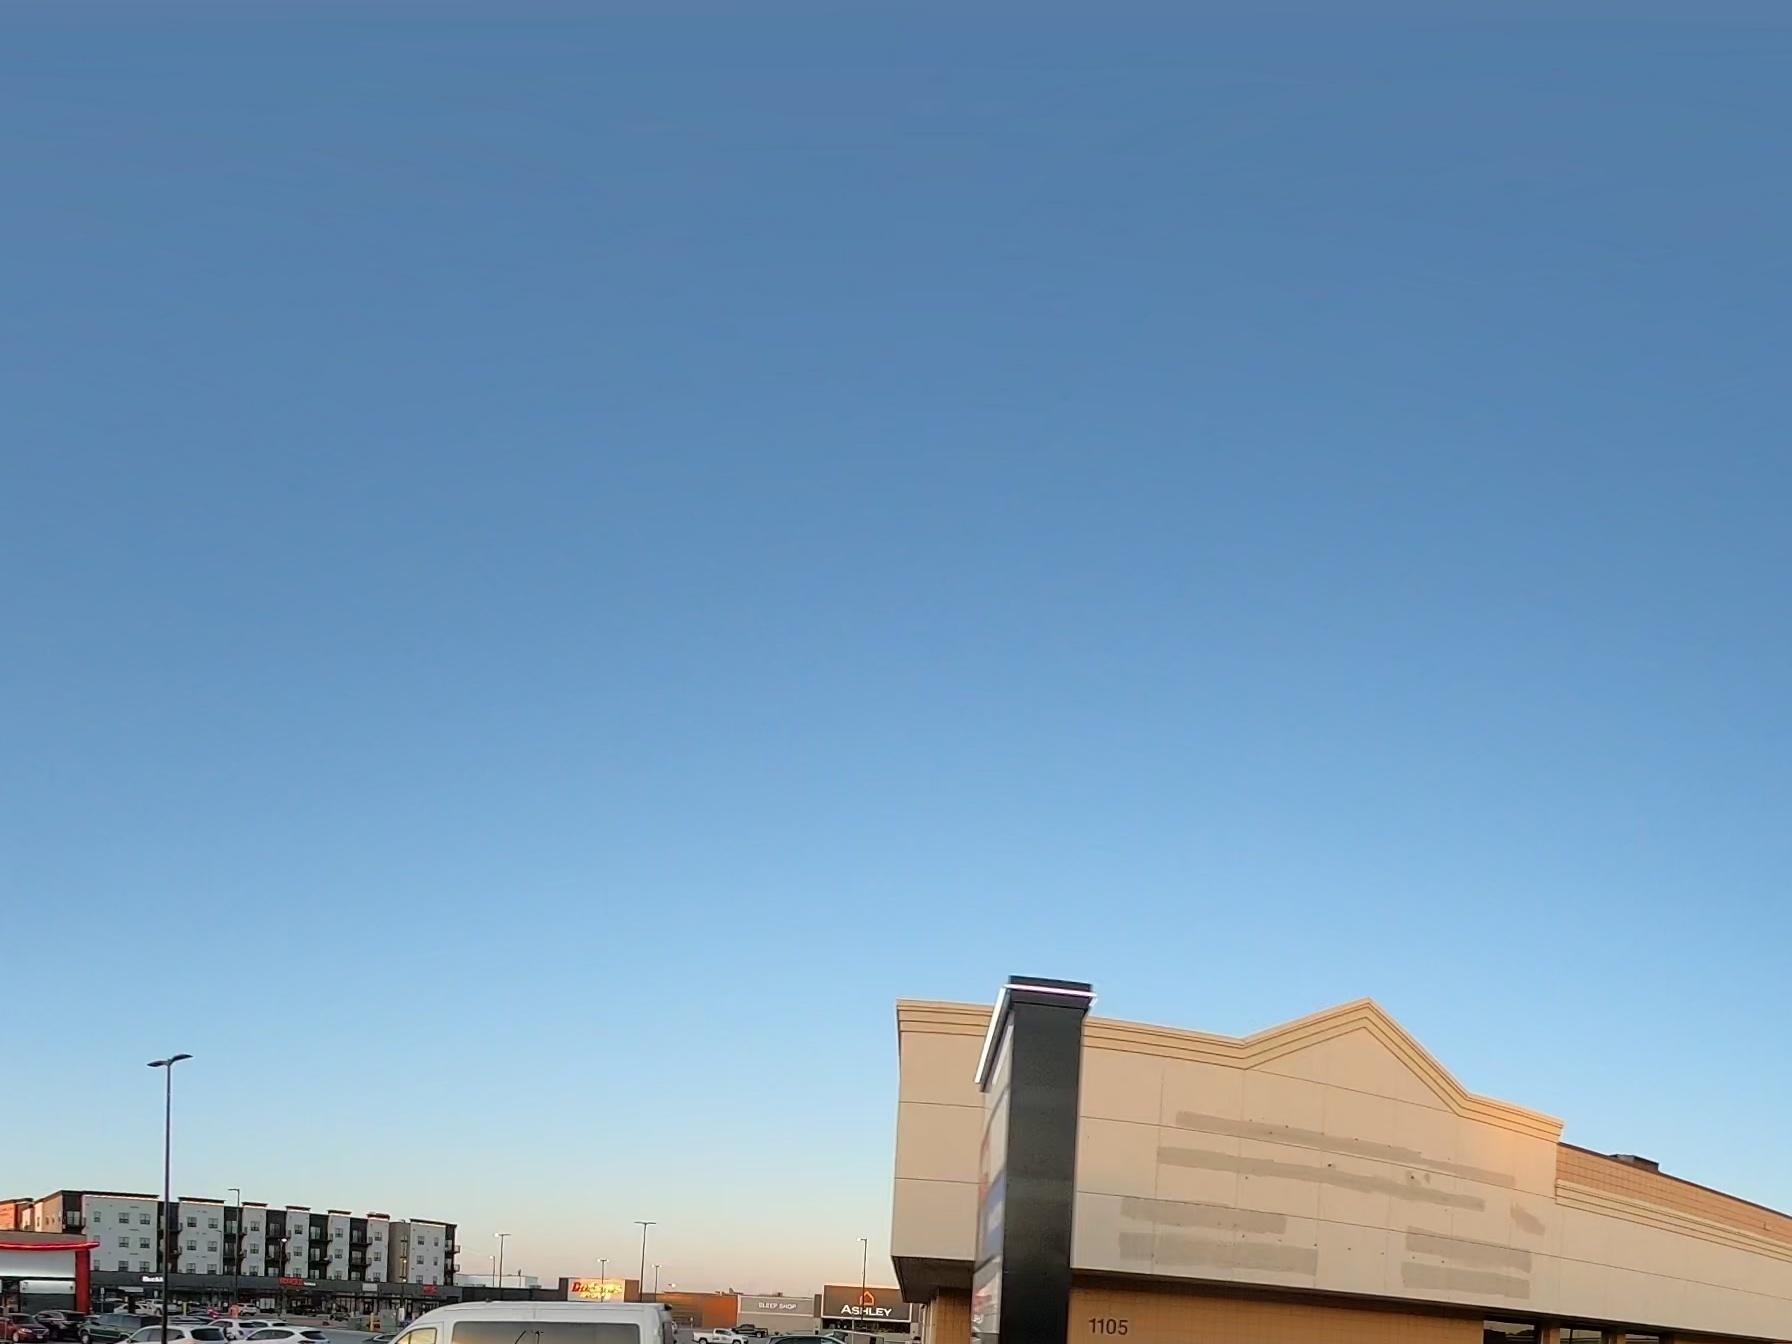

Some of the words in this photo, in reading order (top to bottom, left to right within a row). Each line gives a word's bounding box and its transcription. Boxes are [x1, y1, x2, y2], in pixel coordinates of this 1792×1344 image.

[758, 1301, 777, 1309] SLEEP
[841, 1304, 892, 1317] ASHLEY
[1088, 1317, 1128, 1336] 1105
